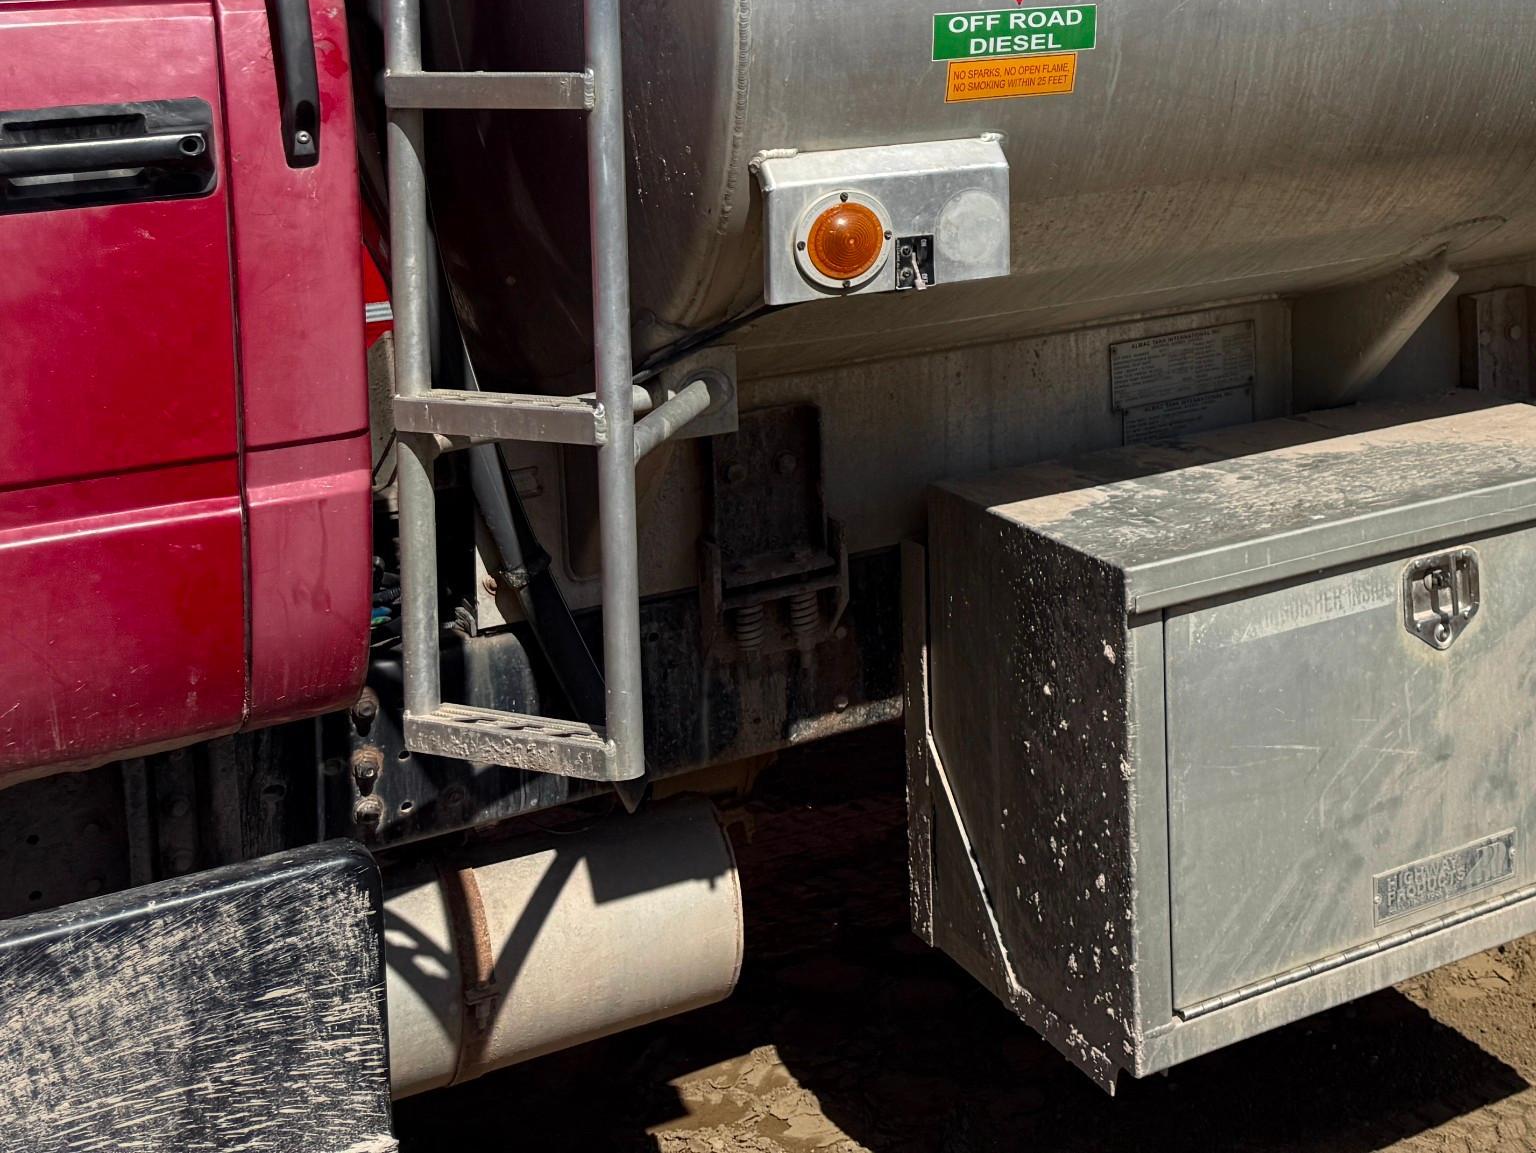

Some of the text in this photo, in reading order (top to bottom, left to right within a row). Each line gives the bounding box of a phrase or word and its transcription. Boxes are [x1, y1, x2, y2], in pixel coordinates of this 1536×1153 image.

[948, 9, 1083, 33] OFF ROAD
[969, 33, 1062, 55] DIESEL
[953, 70, 966, 81] NO
[1004, 65, 1017, 77] NO
[1018, 64, 1041, 75] OPEN
[952, 74, 1069, 93] NO SMOKING WITHIN 25 FEET
